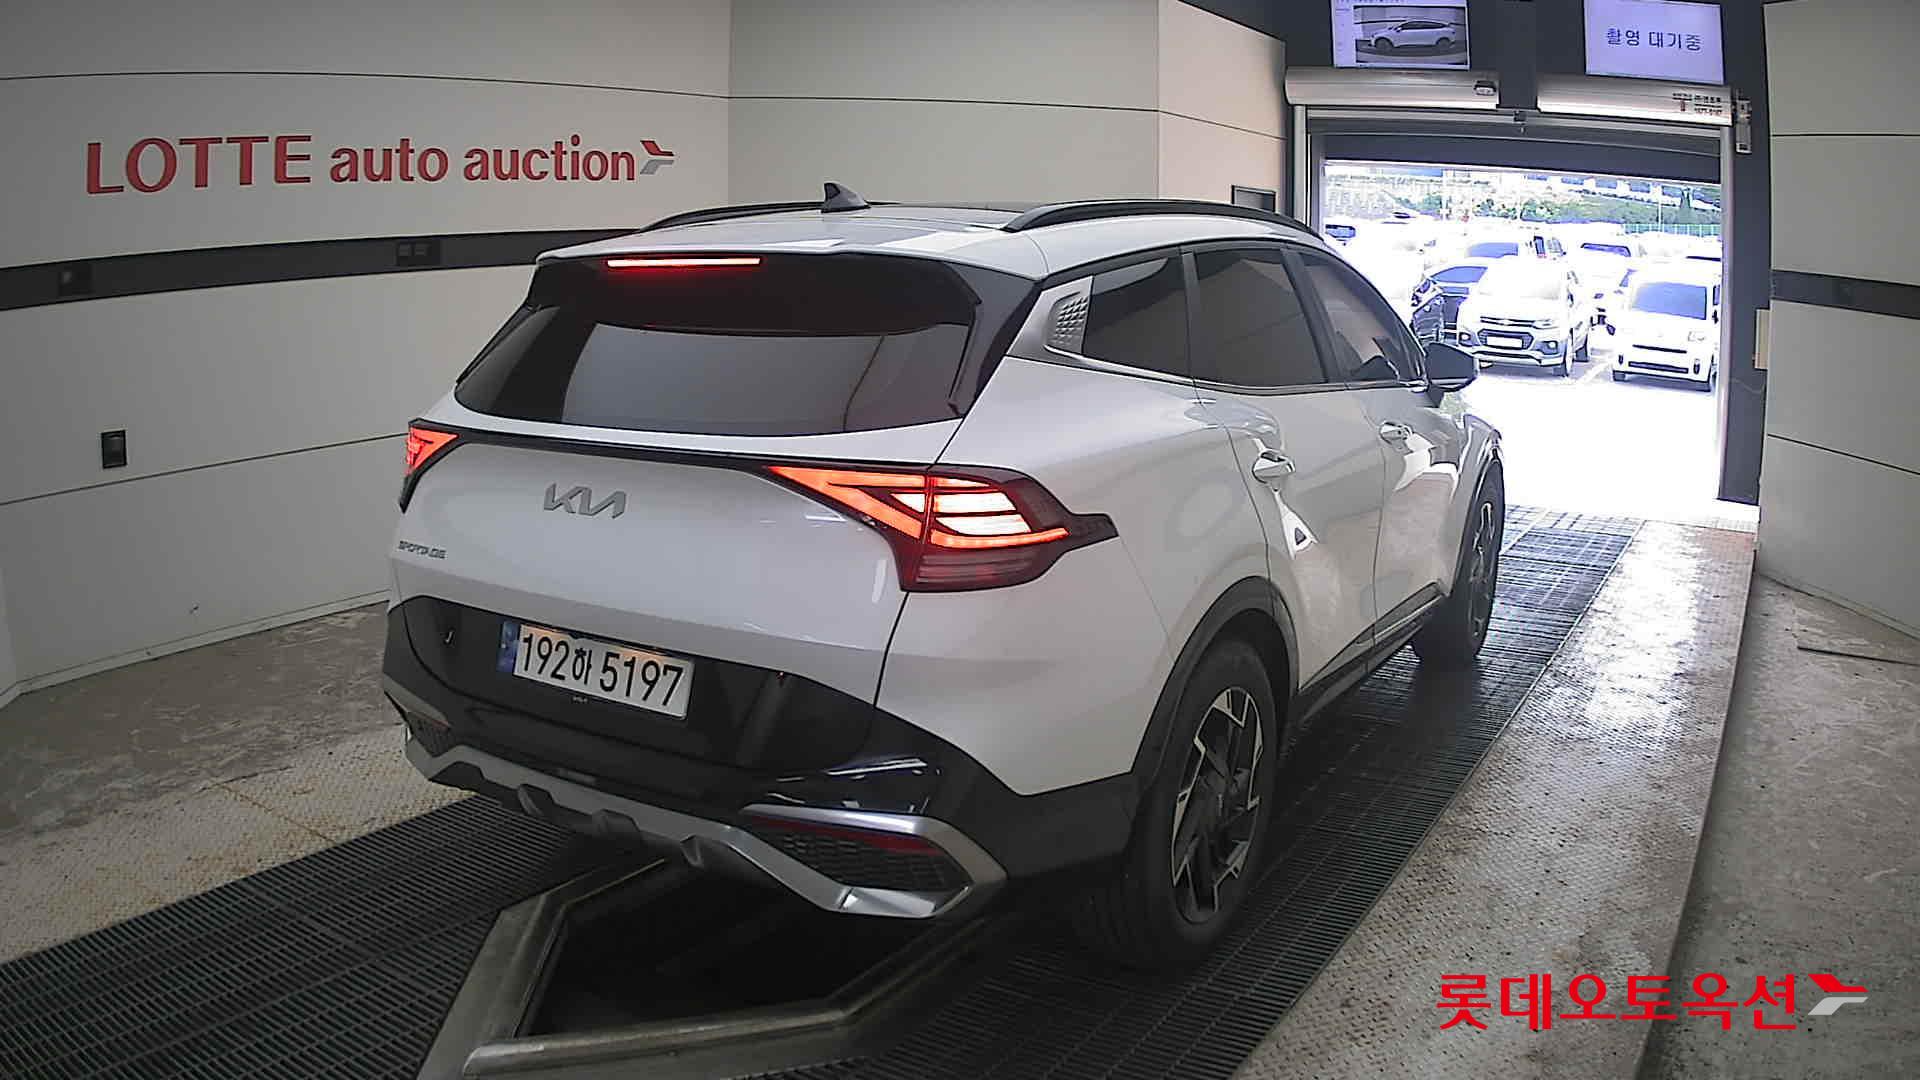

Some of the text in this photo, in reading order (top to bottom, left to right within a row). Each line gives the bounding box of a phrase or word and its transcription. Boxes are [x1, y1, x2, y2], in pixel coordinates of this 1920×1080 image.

[1648, 31, 1701, 51] 대기중
[86, 134, 635, 194] LOTTE auto auction
[523, 633, 684, 706] 192하 5197
